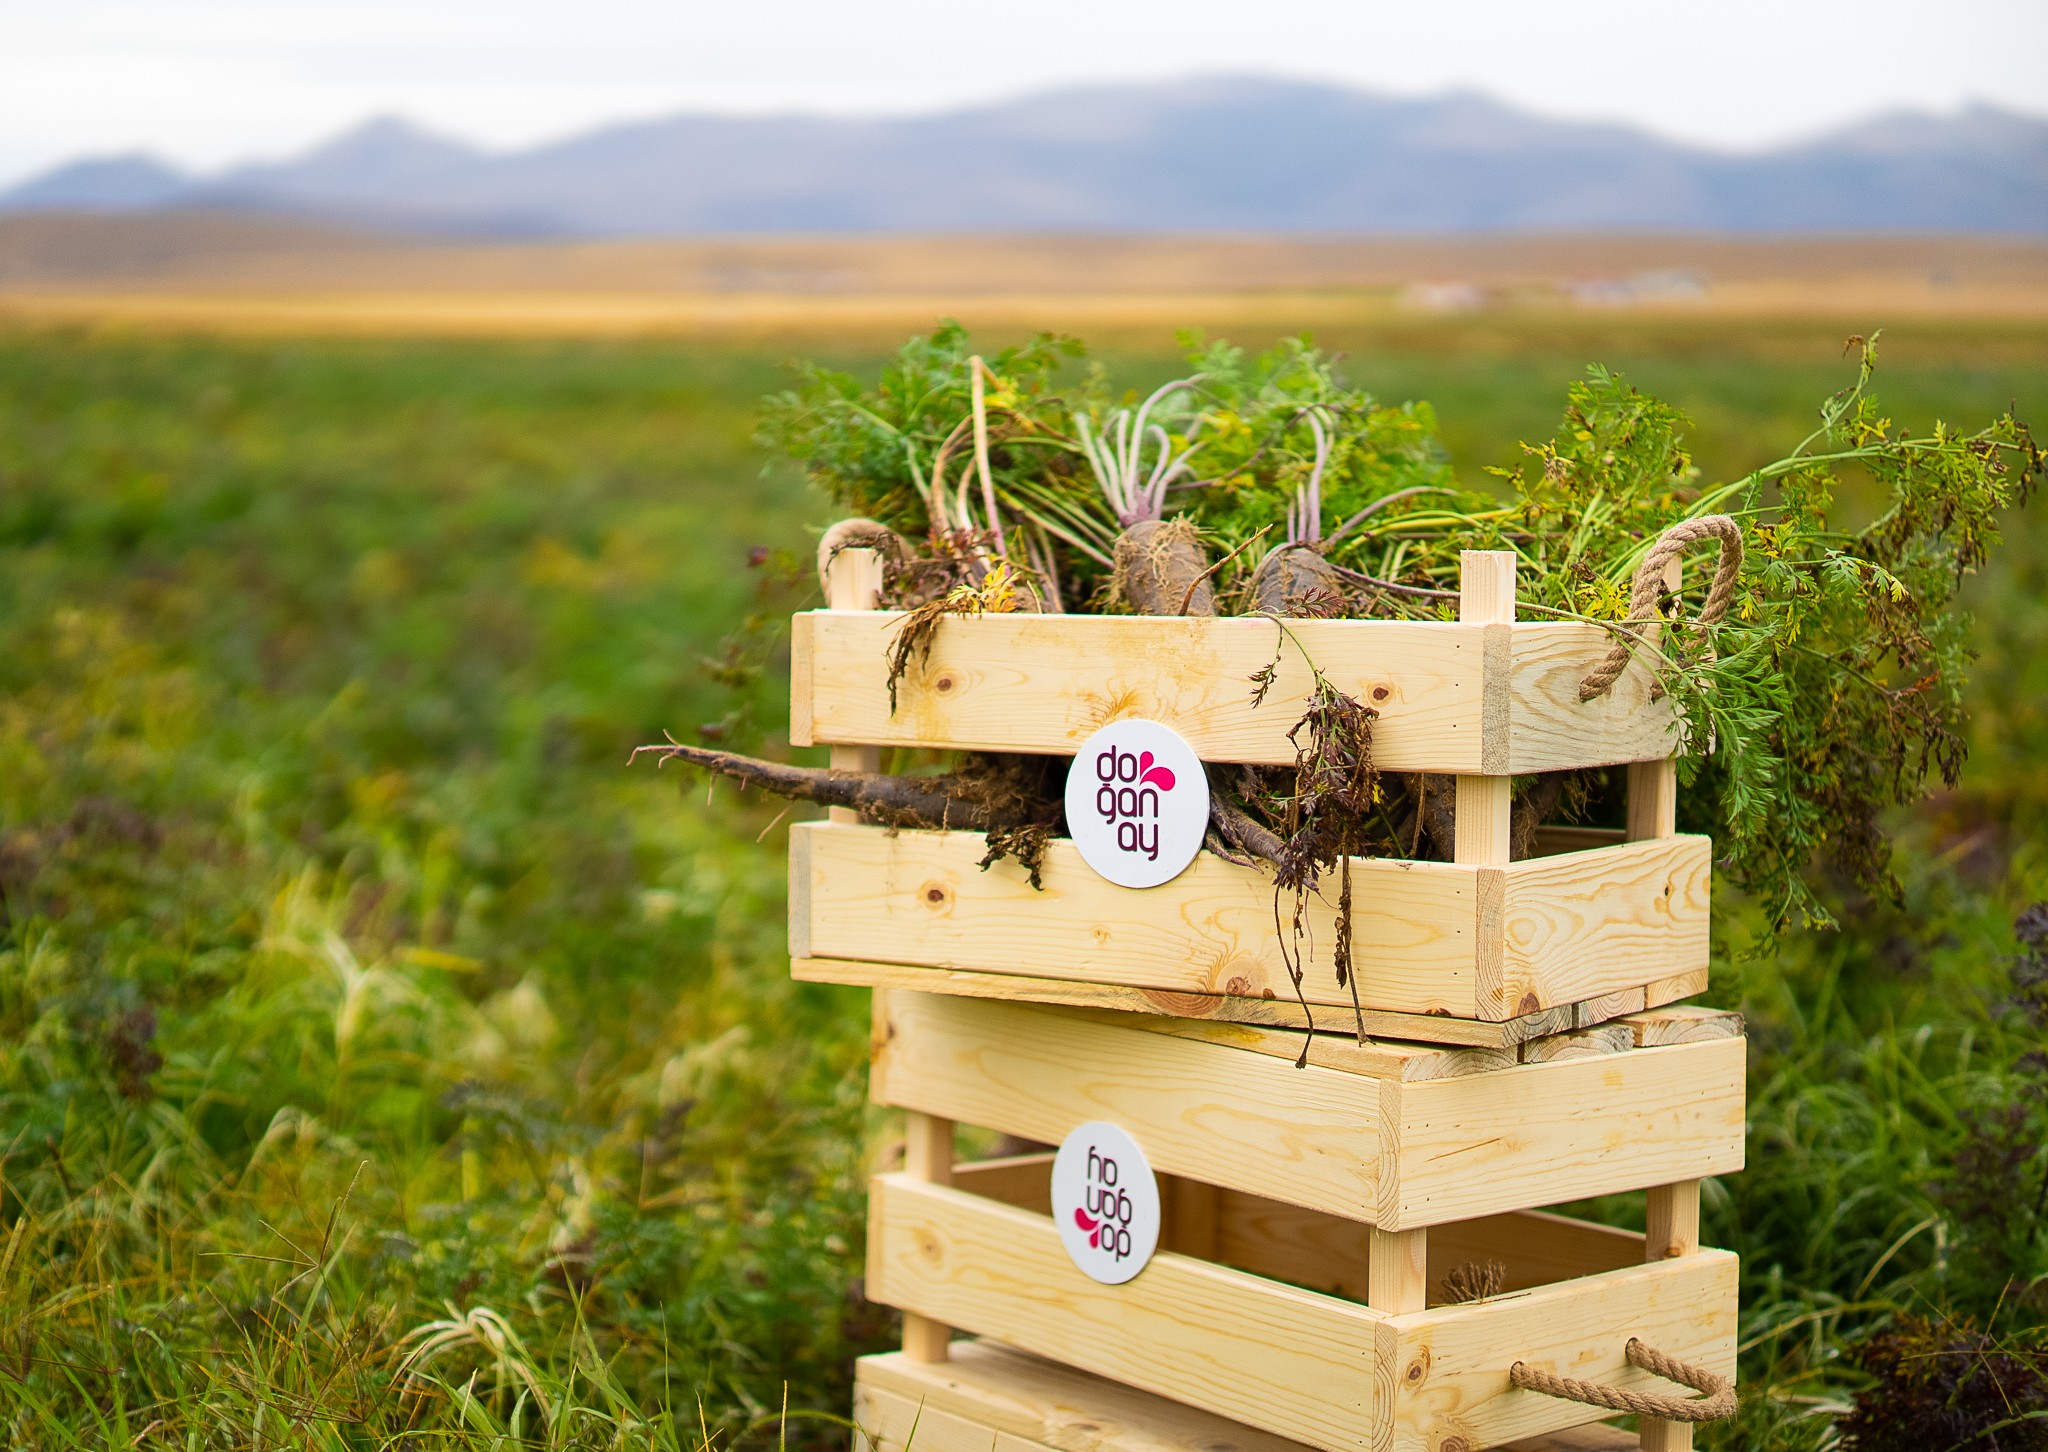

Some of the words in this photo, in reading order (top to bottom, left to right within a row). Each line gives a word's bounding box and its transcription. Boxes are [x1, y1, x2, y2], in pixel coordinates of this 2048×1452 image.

[1096, 744, 1138, 783] do
[1117, 821, 1159, 862] ay
[1087, 1145, 1118, 1187] ay
[1101, 1223, 1132, 1263] do
